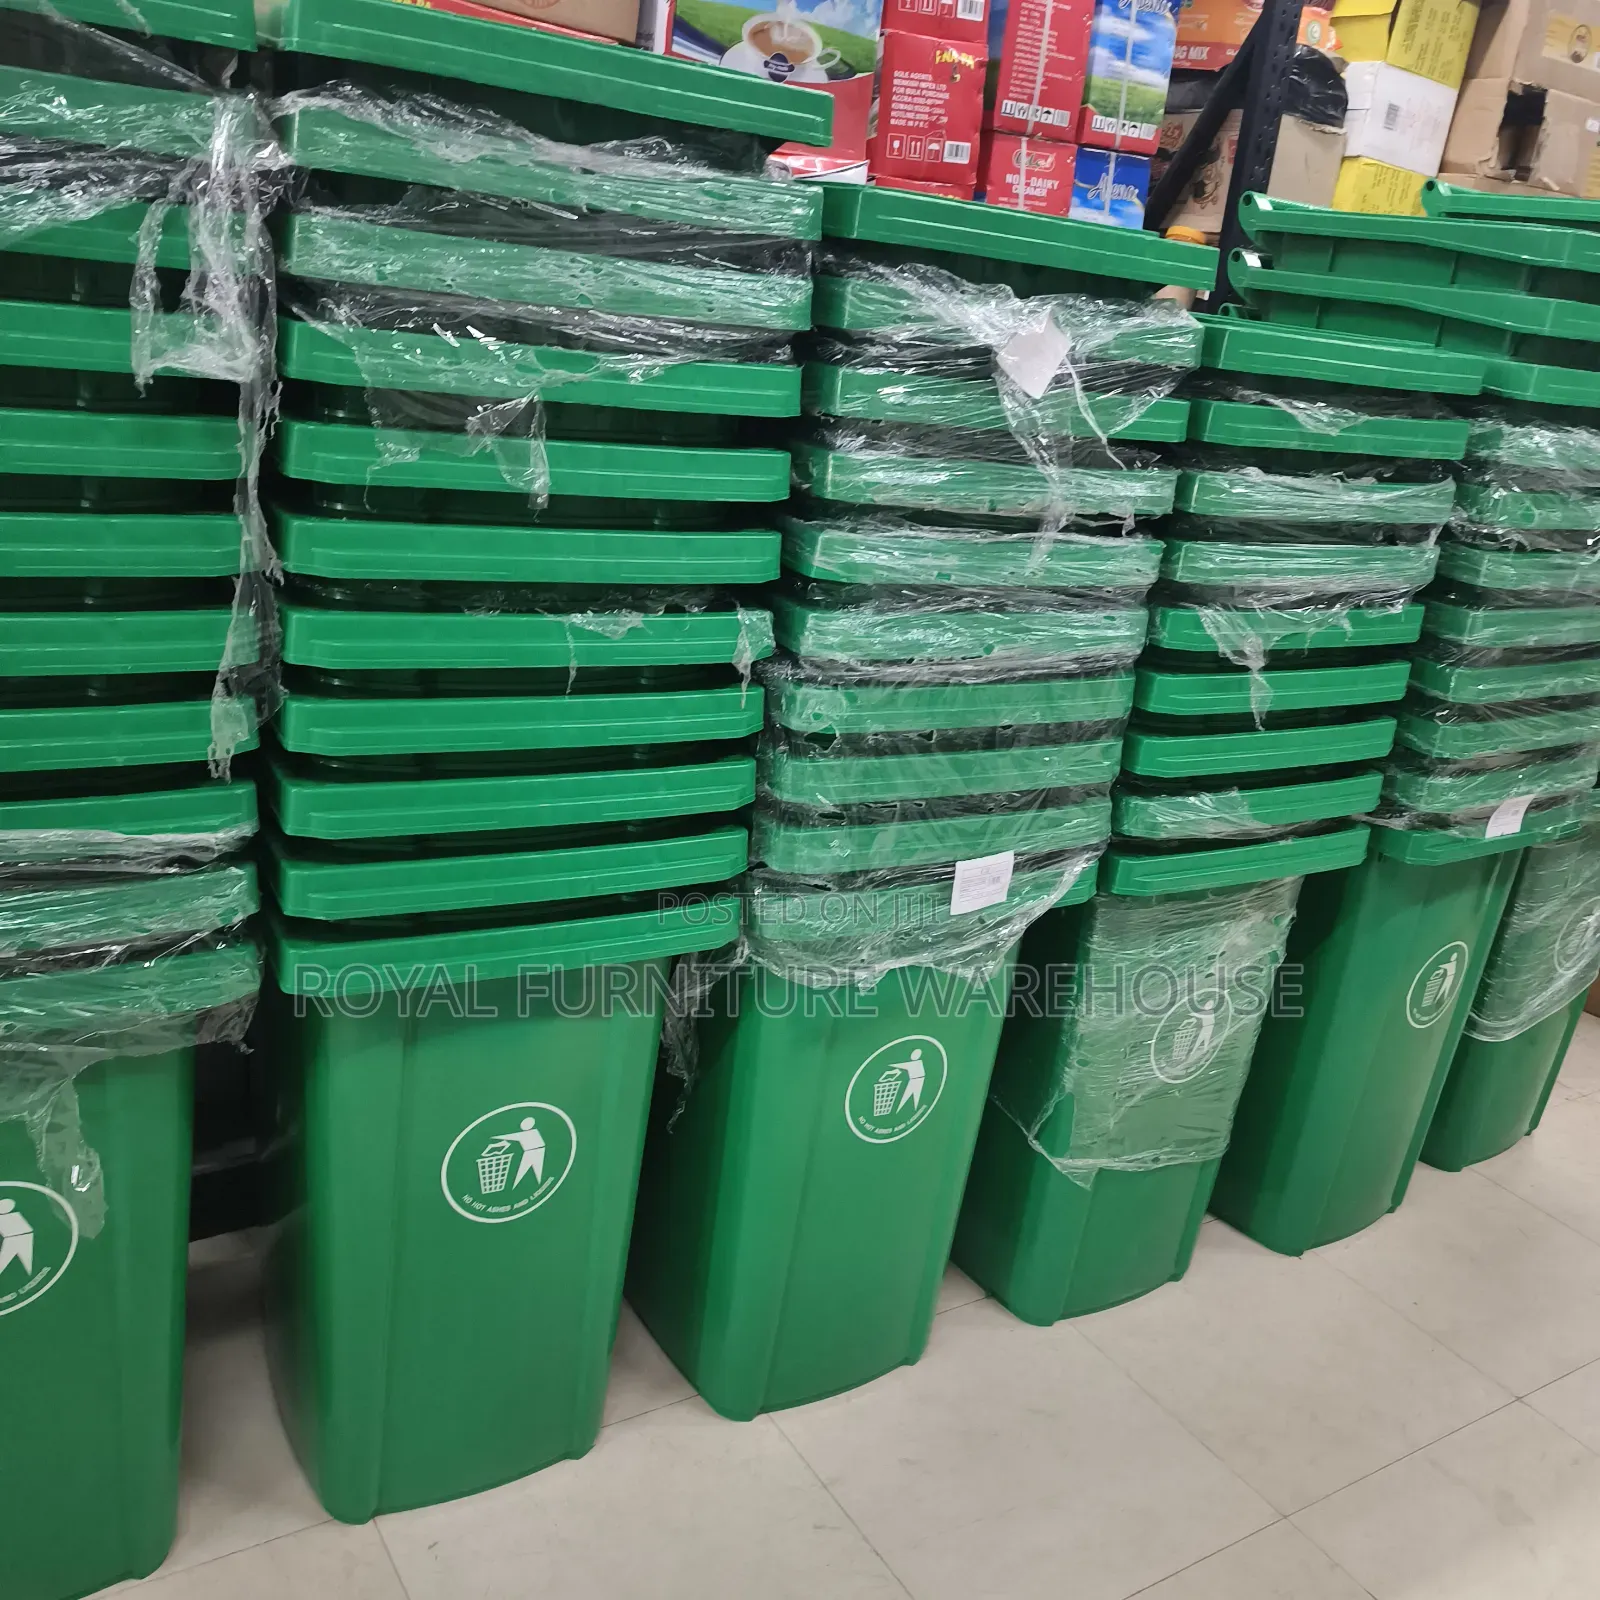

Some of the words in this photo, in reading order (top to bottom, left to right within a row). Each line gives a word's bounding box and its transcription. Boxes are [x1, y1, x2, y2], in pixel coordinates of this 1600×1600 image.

[1188, 46, 1211, 60] MIX
[892, 86, 905, 94] FOR
[1006, 173, 1060, 191] NO-DAIRY
[1012, 184, 1047, 198] CEAMER
[462, 1194, 473, 1204] NO
[471, 1201, 486, 1212] HOT
